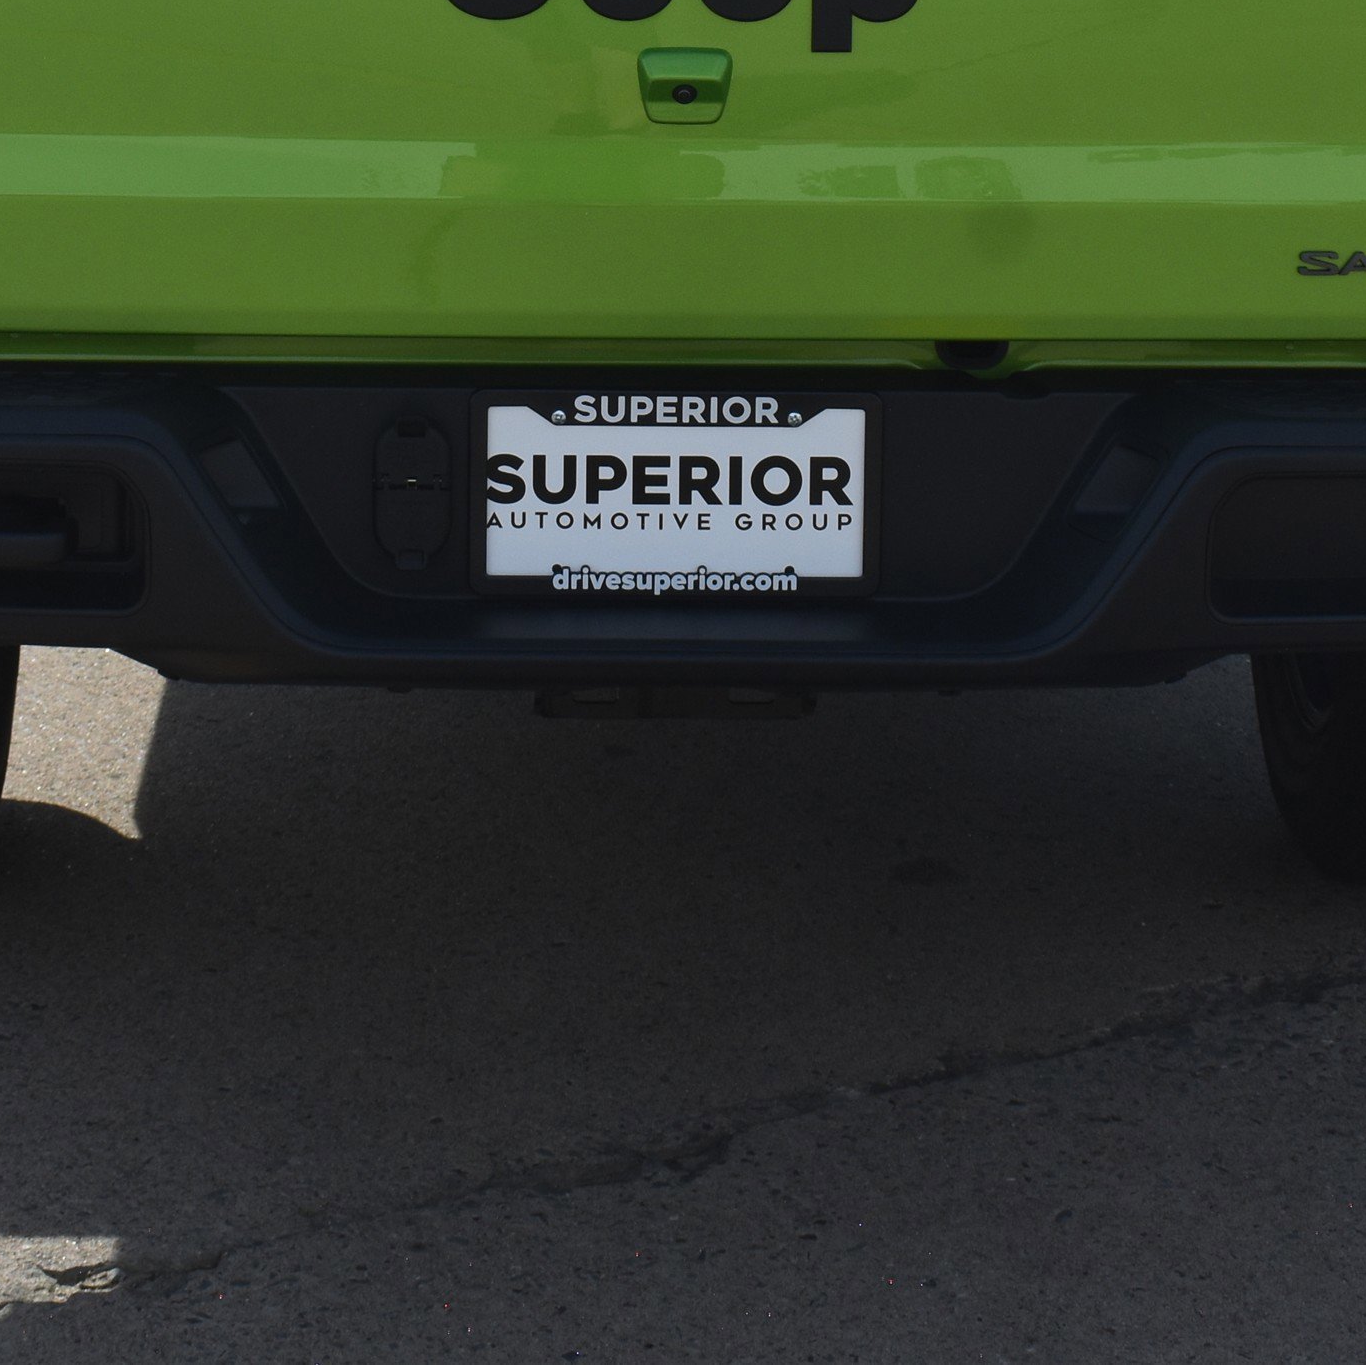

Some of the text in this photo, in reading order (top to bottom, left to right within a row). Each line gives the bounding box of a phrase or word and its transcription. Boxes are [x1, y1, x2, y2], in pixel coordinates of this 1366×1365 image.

[574, 394, 780, 424] SUPERIOR
[486, 453, 854, 506] SUPERIOR
[487, 511, 854, 531] AUTOMOTIVE GROUP
[552, 566, 798, 595] drivesuperior.com
